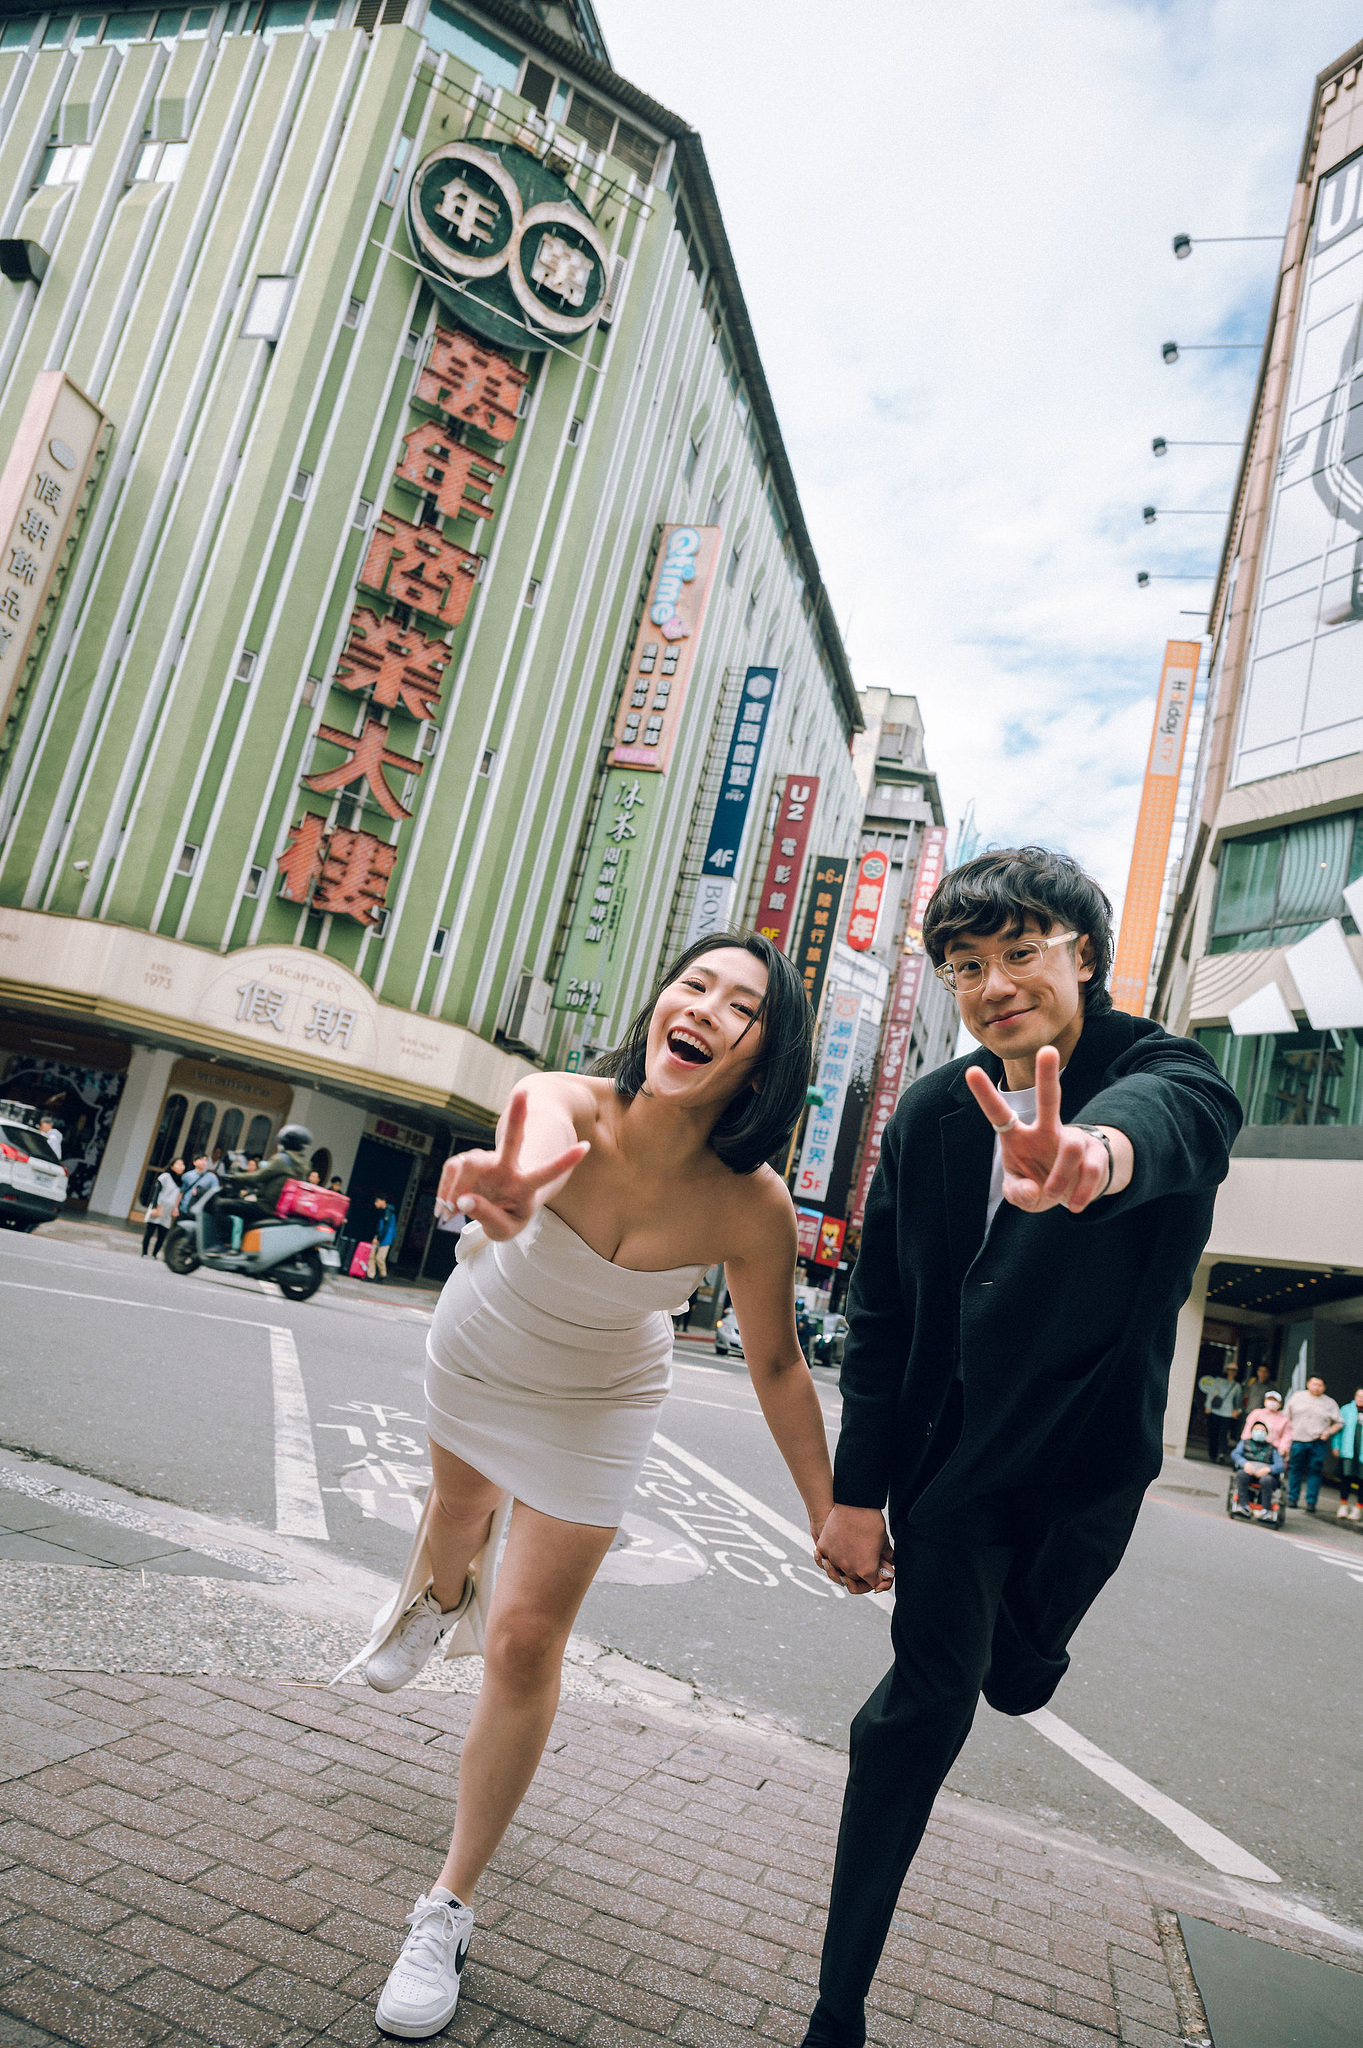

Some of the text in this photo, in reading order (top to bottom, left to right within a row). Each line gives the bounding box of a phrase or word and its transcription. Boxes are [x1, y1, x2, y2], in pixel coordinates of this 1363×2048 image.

[1317, 164, 1363, 243] U
[650, 526, 701, 626] Qtime
[276, 324, 530, 927] 萬年商業大樓
[585, 846, 622, 943] 閱讀咖啡館
[708, 848, 735, 868] 4F
[768, 838, 797, 912] 電影館
[849, 884, 881, 942] 萬年
[236, 980, 358, 1049] 假期
[800, 1170, 822, 1191] 5F
